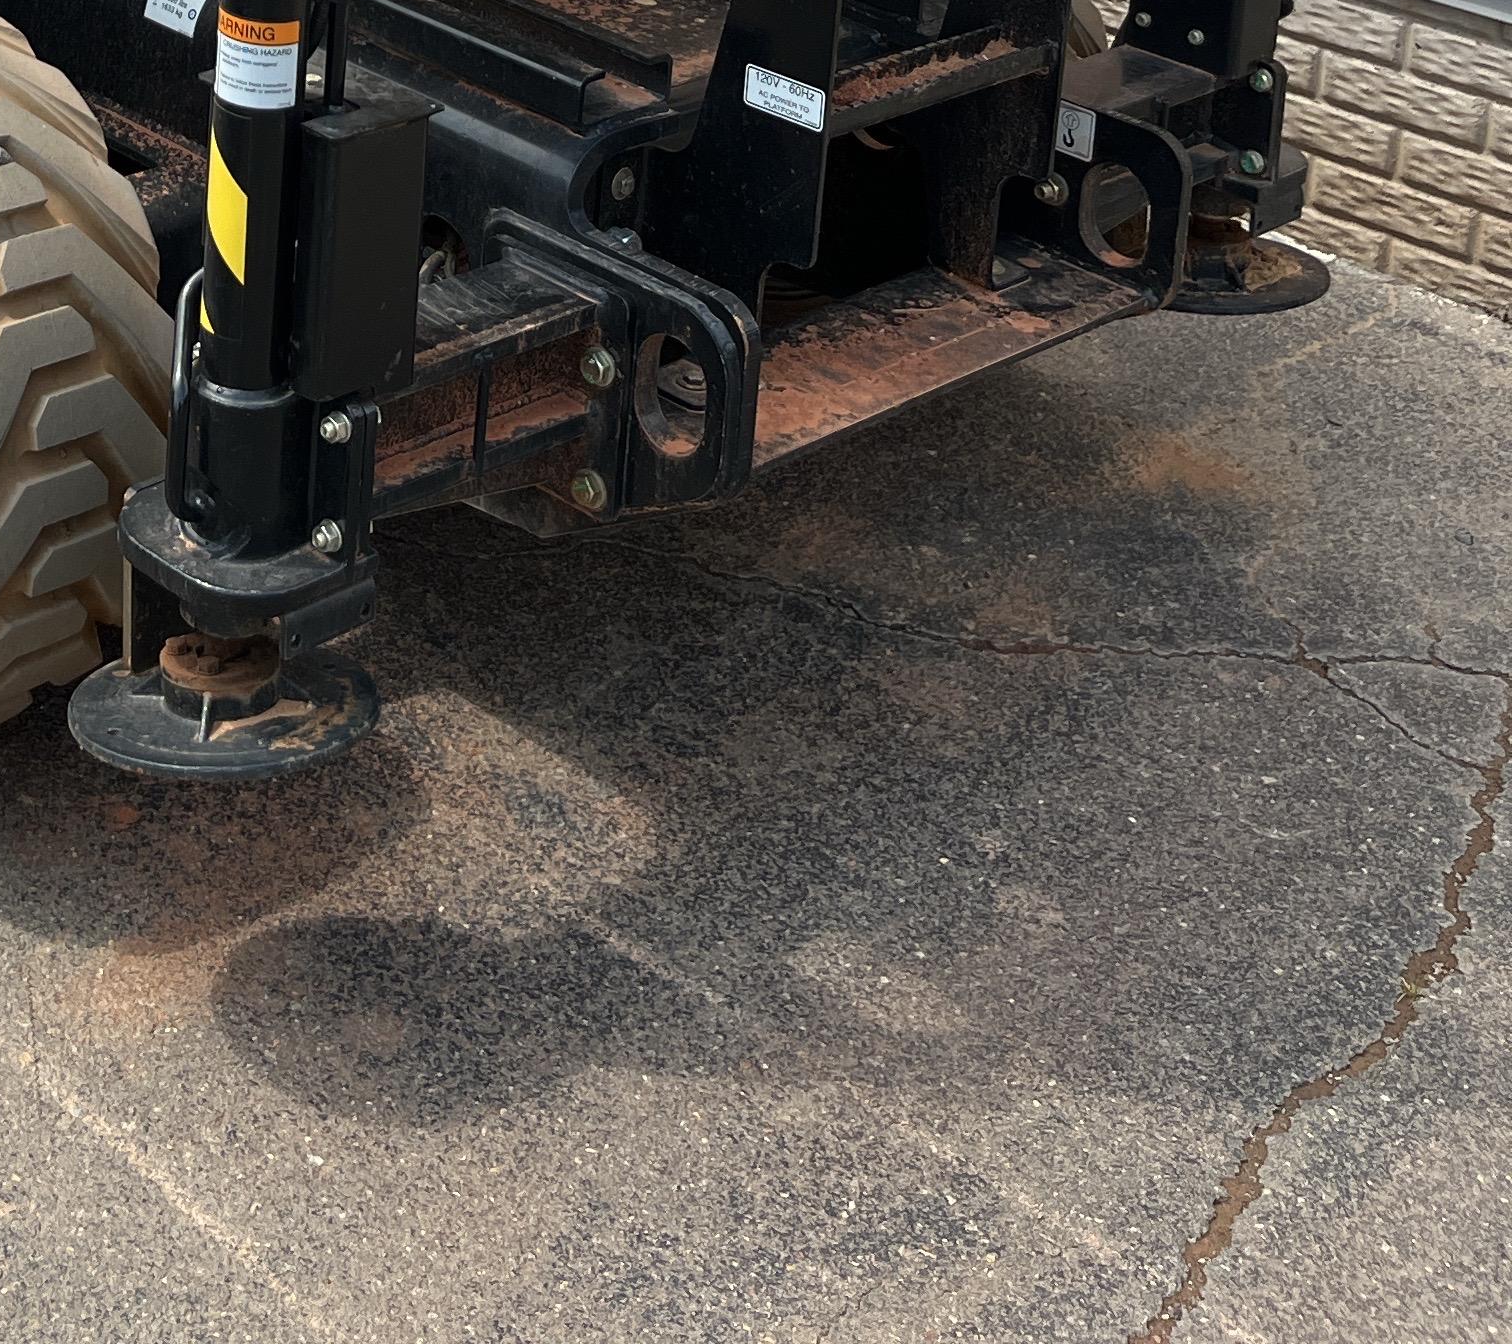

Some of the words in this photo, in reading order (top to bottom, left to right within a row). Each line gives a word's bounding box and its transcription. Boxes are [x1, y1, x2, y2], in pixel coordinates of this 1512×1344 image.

[259, 47, 293, 57] HAZARD
[755, 71, 781, 88] 120V
[788, 82, 816, 102] 60Hz
[758, 89, 769, 99] AC
[770, 93, 798, 110] POWER
[799, 104, 810, 114] TO
[763, 99, 803, 120] PLATFORM
